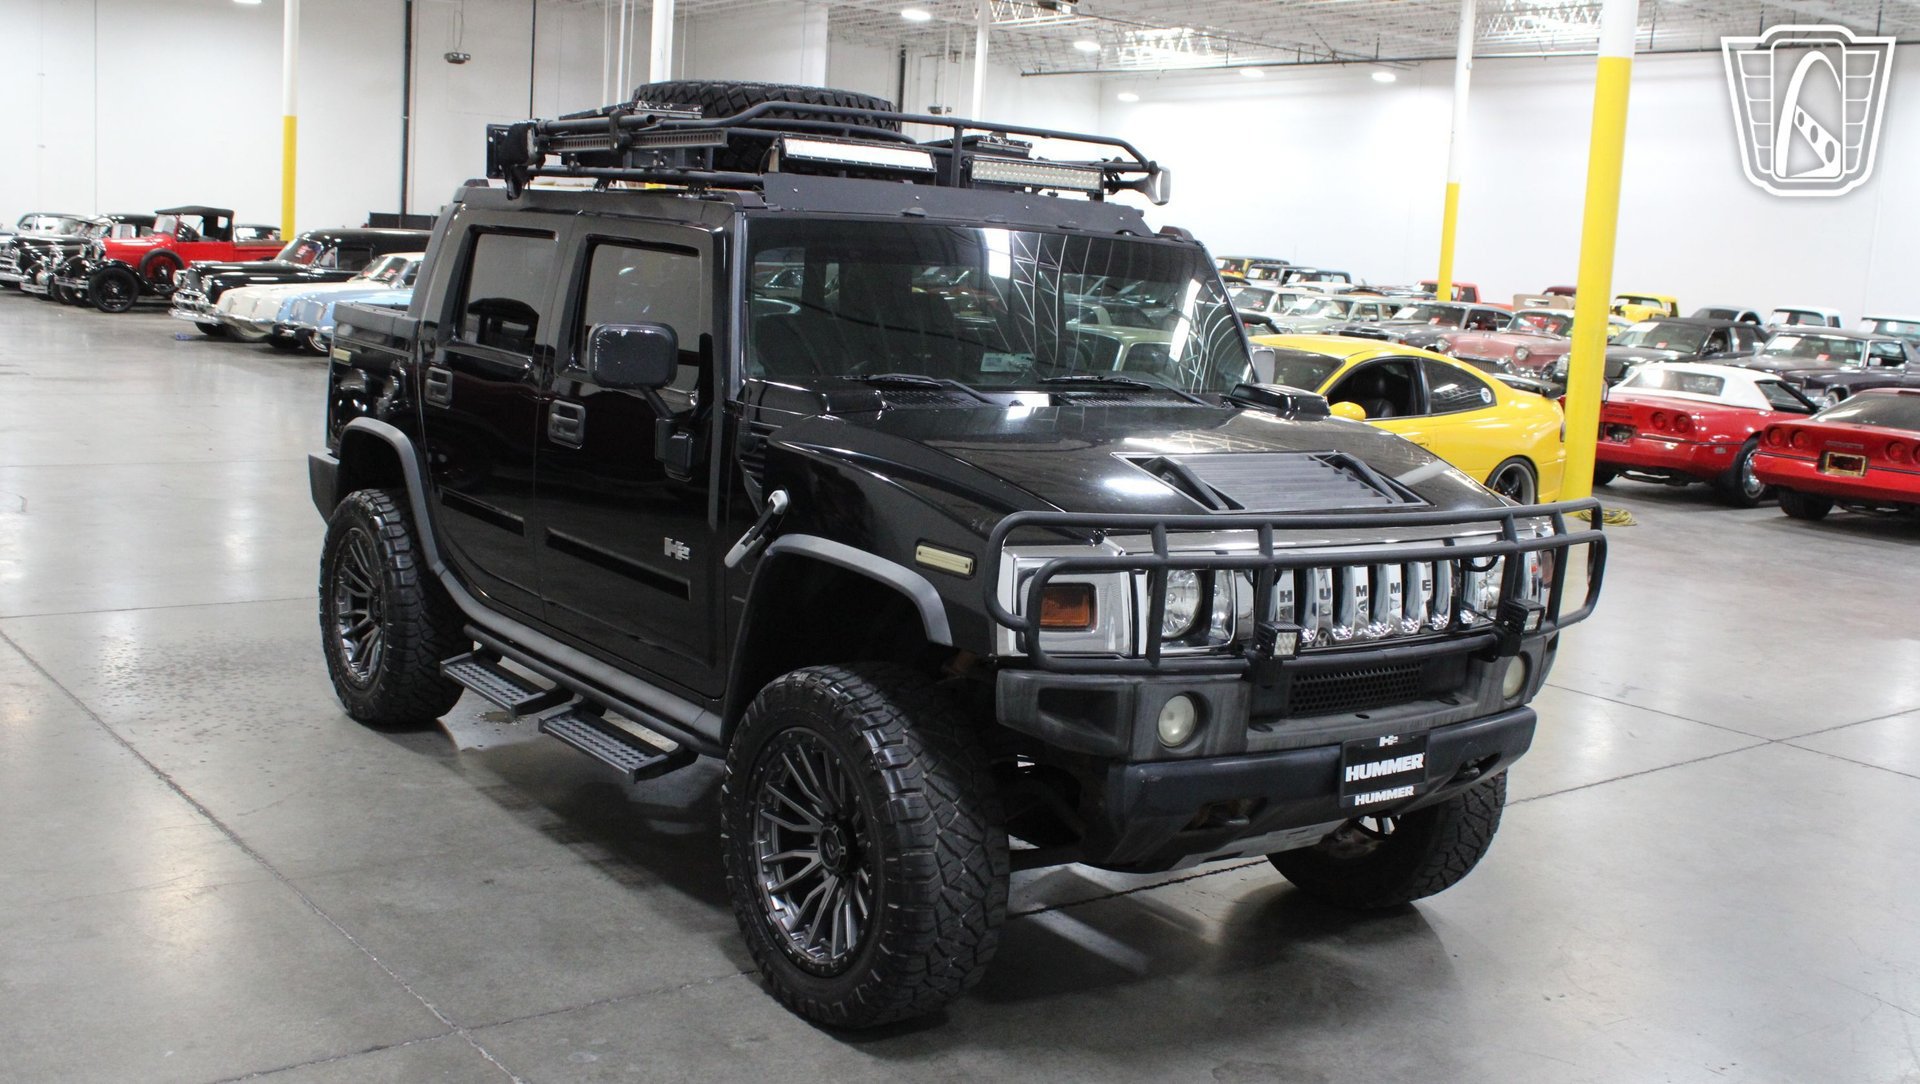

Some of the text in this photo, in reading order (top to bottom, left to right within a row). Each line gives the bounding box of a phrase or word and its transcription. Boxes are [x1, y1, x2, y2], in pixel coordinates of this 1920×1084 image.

[664, 537, 690, 561] H2
[1279, 579, 1432, 602] HUMME
[1345, 753, 1424, 782] HUMMER
[1354, 785, 1414, 806] HUMMER
